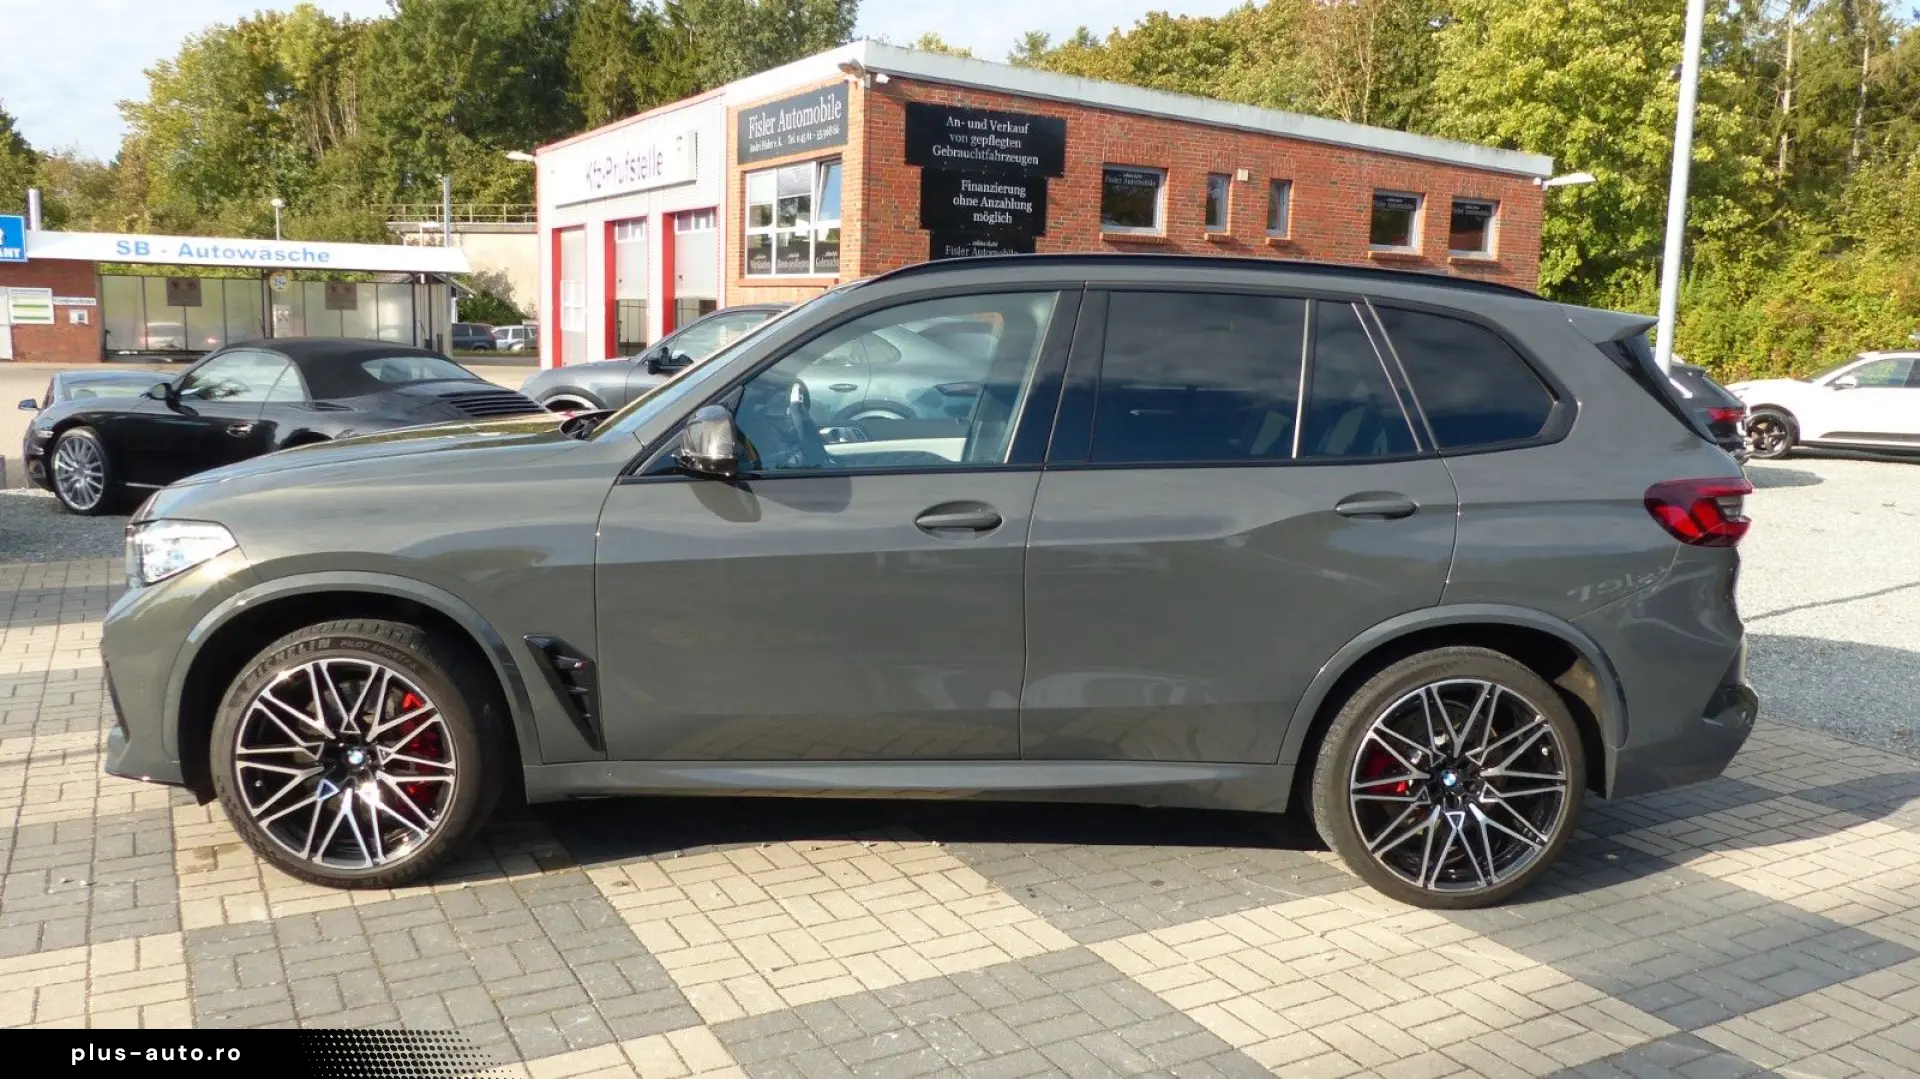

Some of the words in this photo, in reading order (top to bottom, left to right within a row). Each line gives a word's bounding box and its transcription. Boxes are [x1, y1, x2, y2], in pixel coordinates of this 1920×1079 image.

[748, 111, 776, 139] Fisler
[777, 92, 842, 132] Automobile
[946, 116, 965, 127] An-
[968, 119, 987, 130] und
[990, 120, 1029, 134] Verkauf
[949, 133, 968, 144] von
[970, 134, 1021, 149] gepflegten
[932, 145, 1039, 166] Gebrauchtfahrzeugen
[961, 179, 1026, 198] Finanzierung
[953, 194, 979, 206] ohne
[980, 197, 1033, 213] Anzahlung
[973, 211, 1013, 225] möglich
[116, 240, 150, 256] SB
